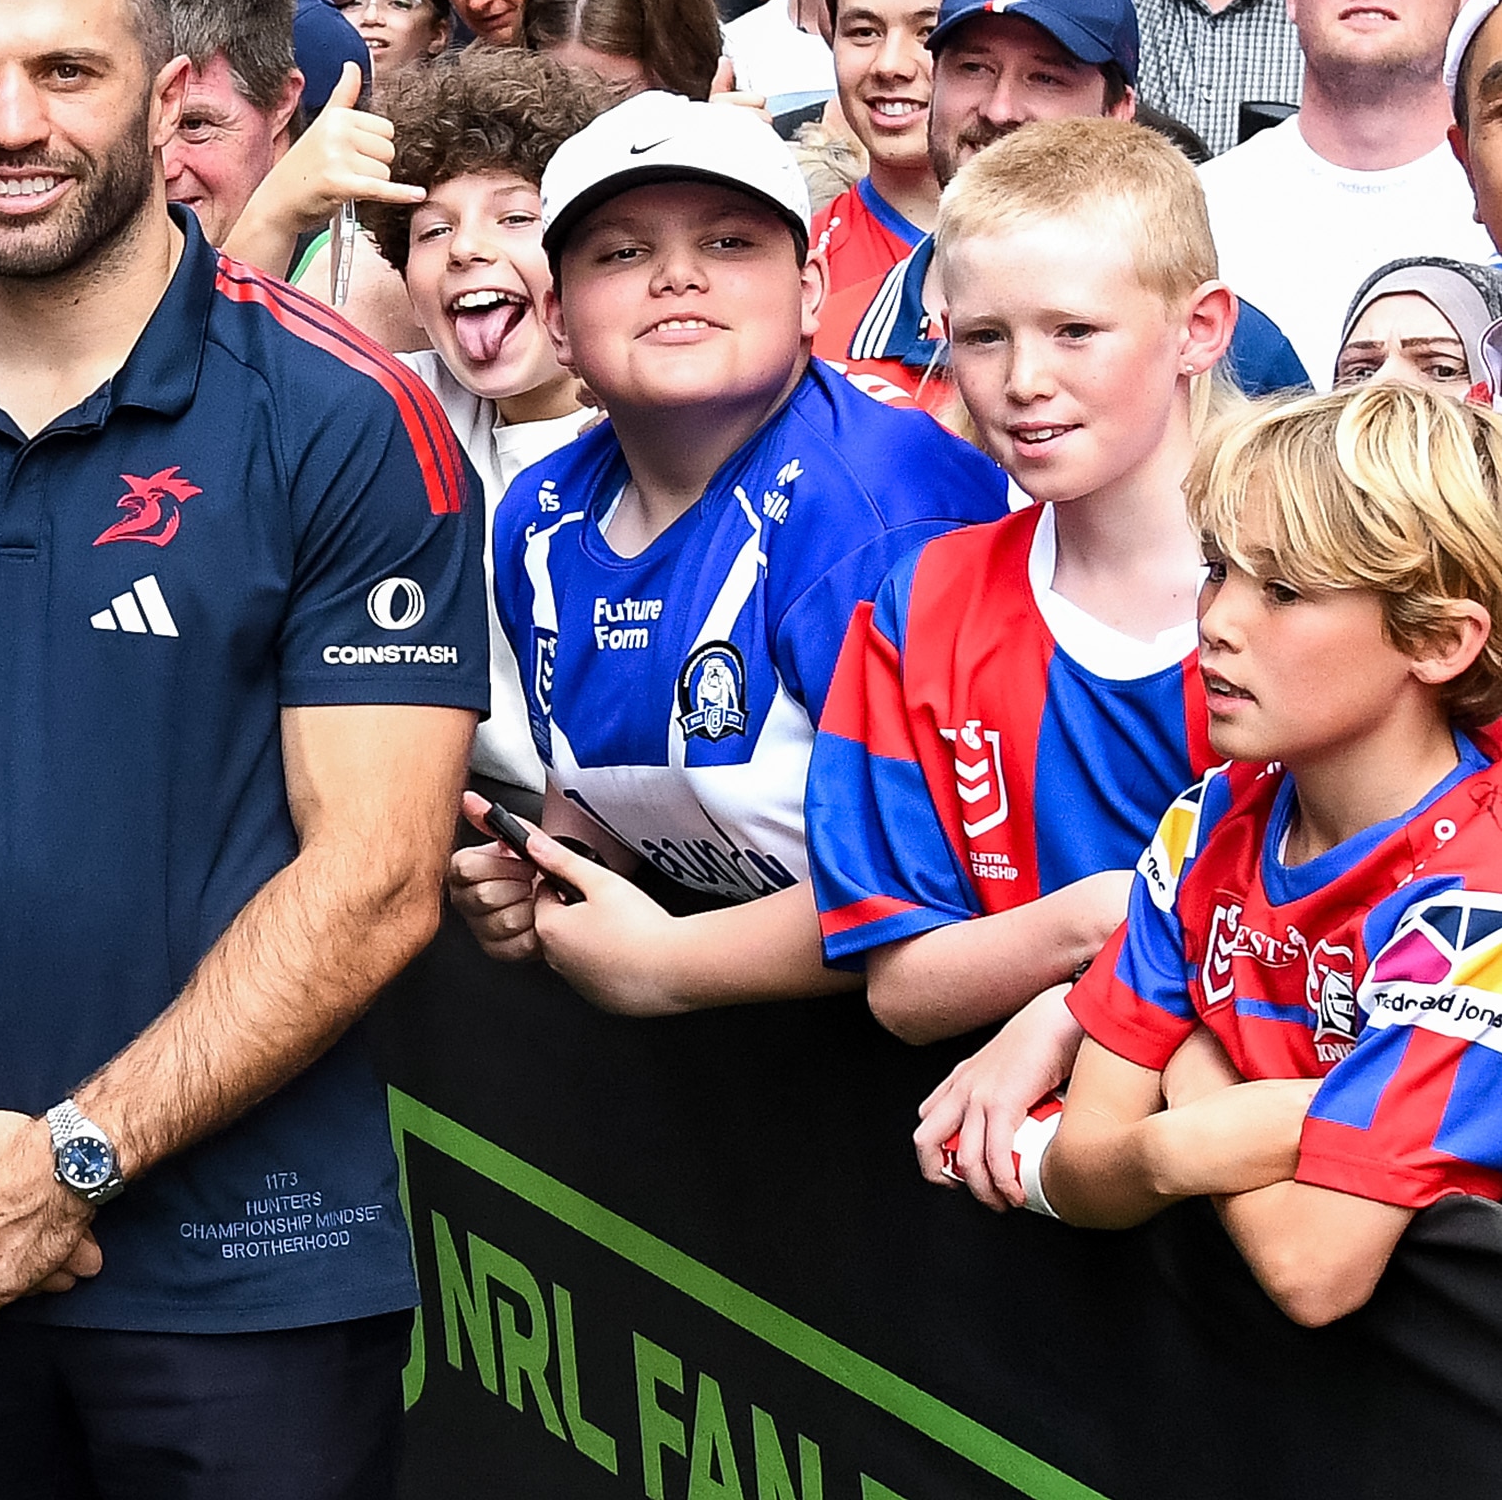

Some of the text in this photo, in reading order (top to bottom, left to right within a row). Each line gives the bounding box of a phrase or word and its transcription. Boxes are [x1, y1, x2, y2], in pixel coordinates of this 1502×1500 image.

[593, 595, 663, 624] Future
[594, 625, 650, 651] Form
[321, 644, 458, 666] COINSTASH
[1235, 927, 1299, 963] ESTS
[265, 1171, 299, 1190] 1173
[246, 1191, 323, 1217] HUNTERS
[179, 1204, 384, 1240] CHAMPIONSHIP MINDSET
[221, 1230, 351, 1260] BROTHERHOOD
[431, 1208, 619, 1476] NRL
